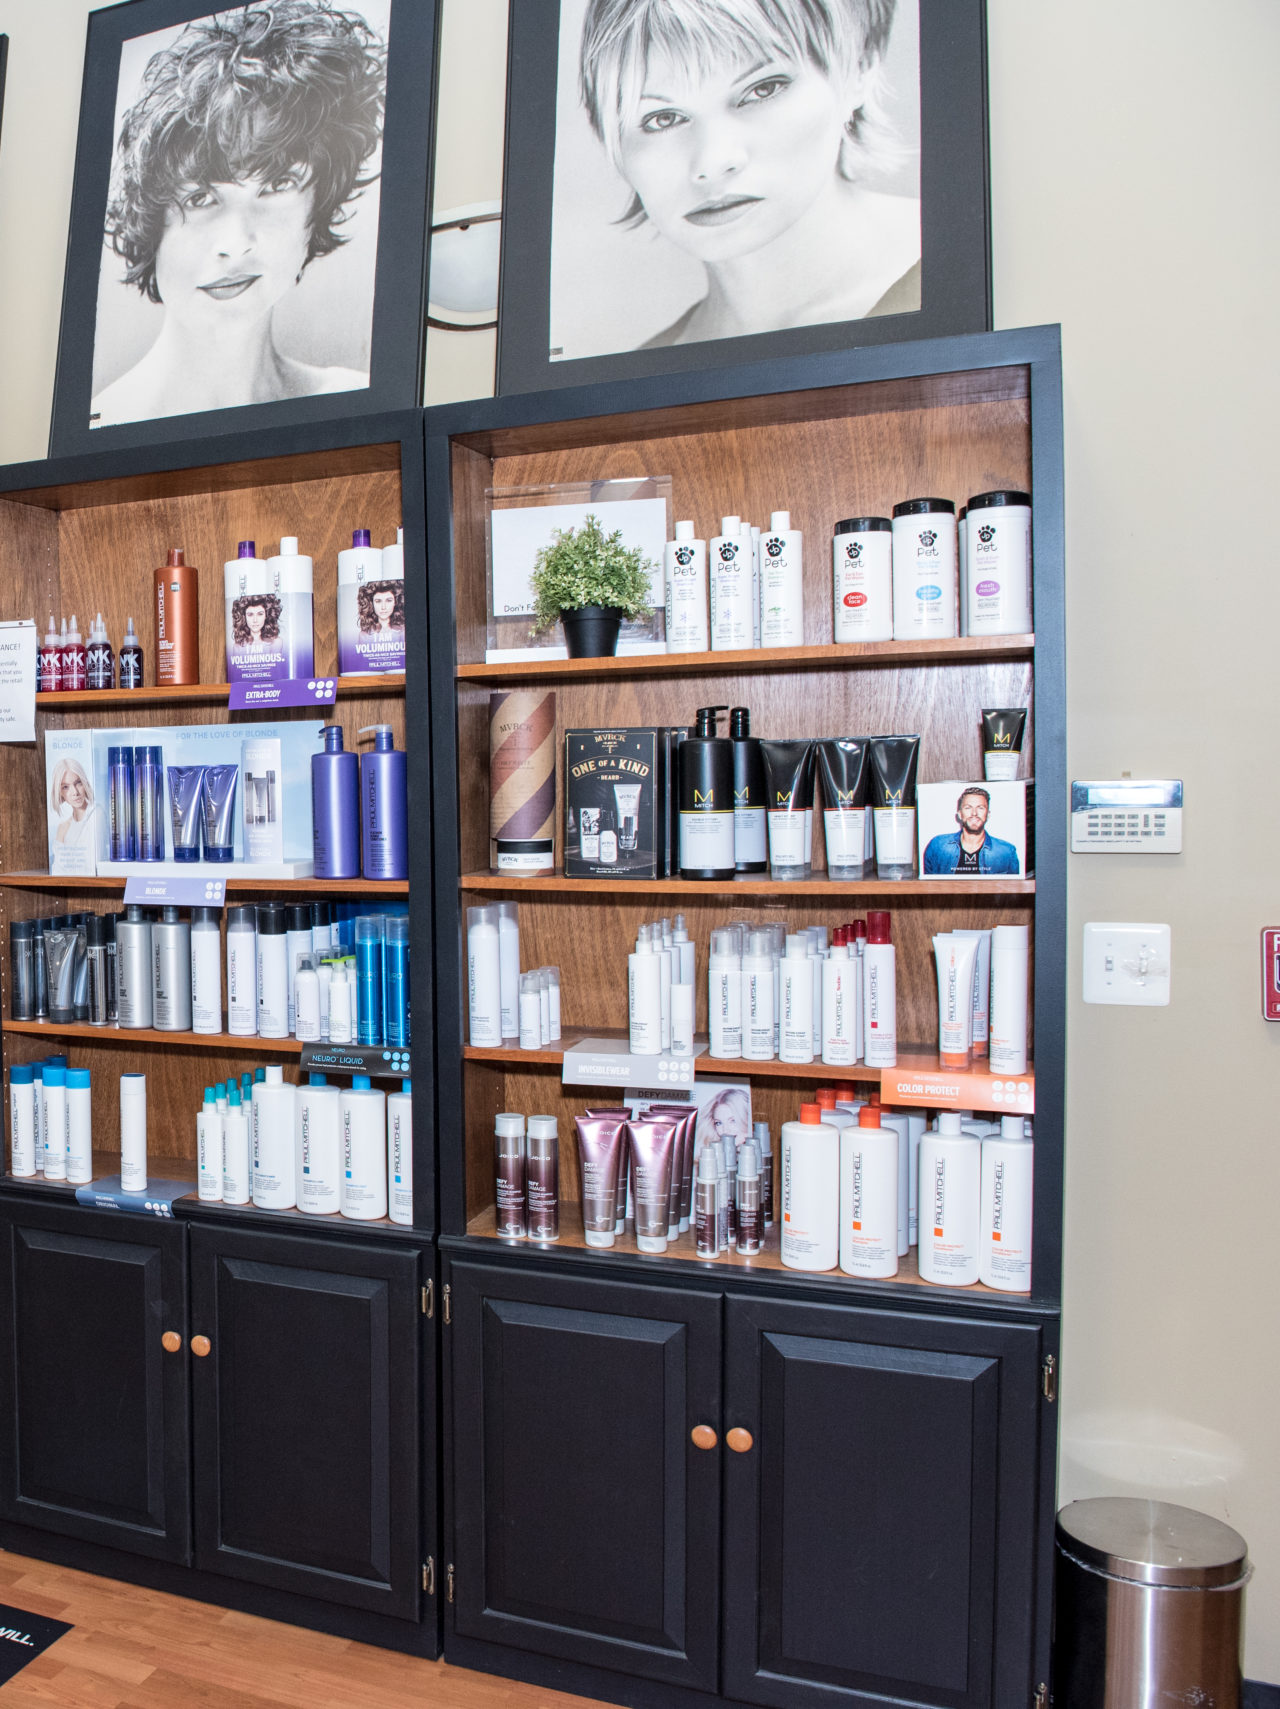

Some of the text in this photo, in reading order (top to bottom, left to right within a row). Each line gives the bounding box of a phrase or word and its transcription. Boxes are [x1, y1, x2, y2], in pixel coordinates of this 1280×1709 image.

[918, 546, 939, 556] Pet
[977, 542, 998, 552] Pet
[718, 562, 740, 572] Pet
[764, 556, 788, 568] Pet
[844, 558, 864, 568] Pet
[674, 566, 696, 576] Pet
[504, 604, 524, 612] Don't
[356, 642, 406, 654] VOLUMINOU
[231, 653, 284, 664] VOLUMINOUS.
[246, 690, 280, 699] EXTRA-BODY
[192, 732, 208, 740] THE
[210, 730, 230, 738] LOVE
[232, 730, 244, 738] OF
[245, 729, 278, 738] BLONDE
[594, 734, 626, 742] MVRCK
[52, 742, 83, 750] BLONDE
[572, 760, 596, 778] ONE
[619, 759, 650, 777] KIND
[340, 1056, 364, 1064] LIQUID
[578, 1064, 630, 1076] INVISIBLEWEAR
[898, 1083, 960, 1096] COLOR PROTECT
[995, 1161, 1004, 1205] MITCHELL
